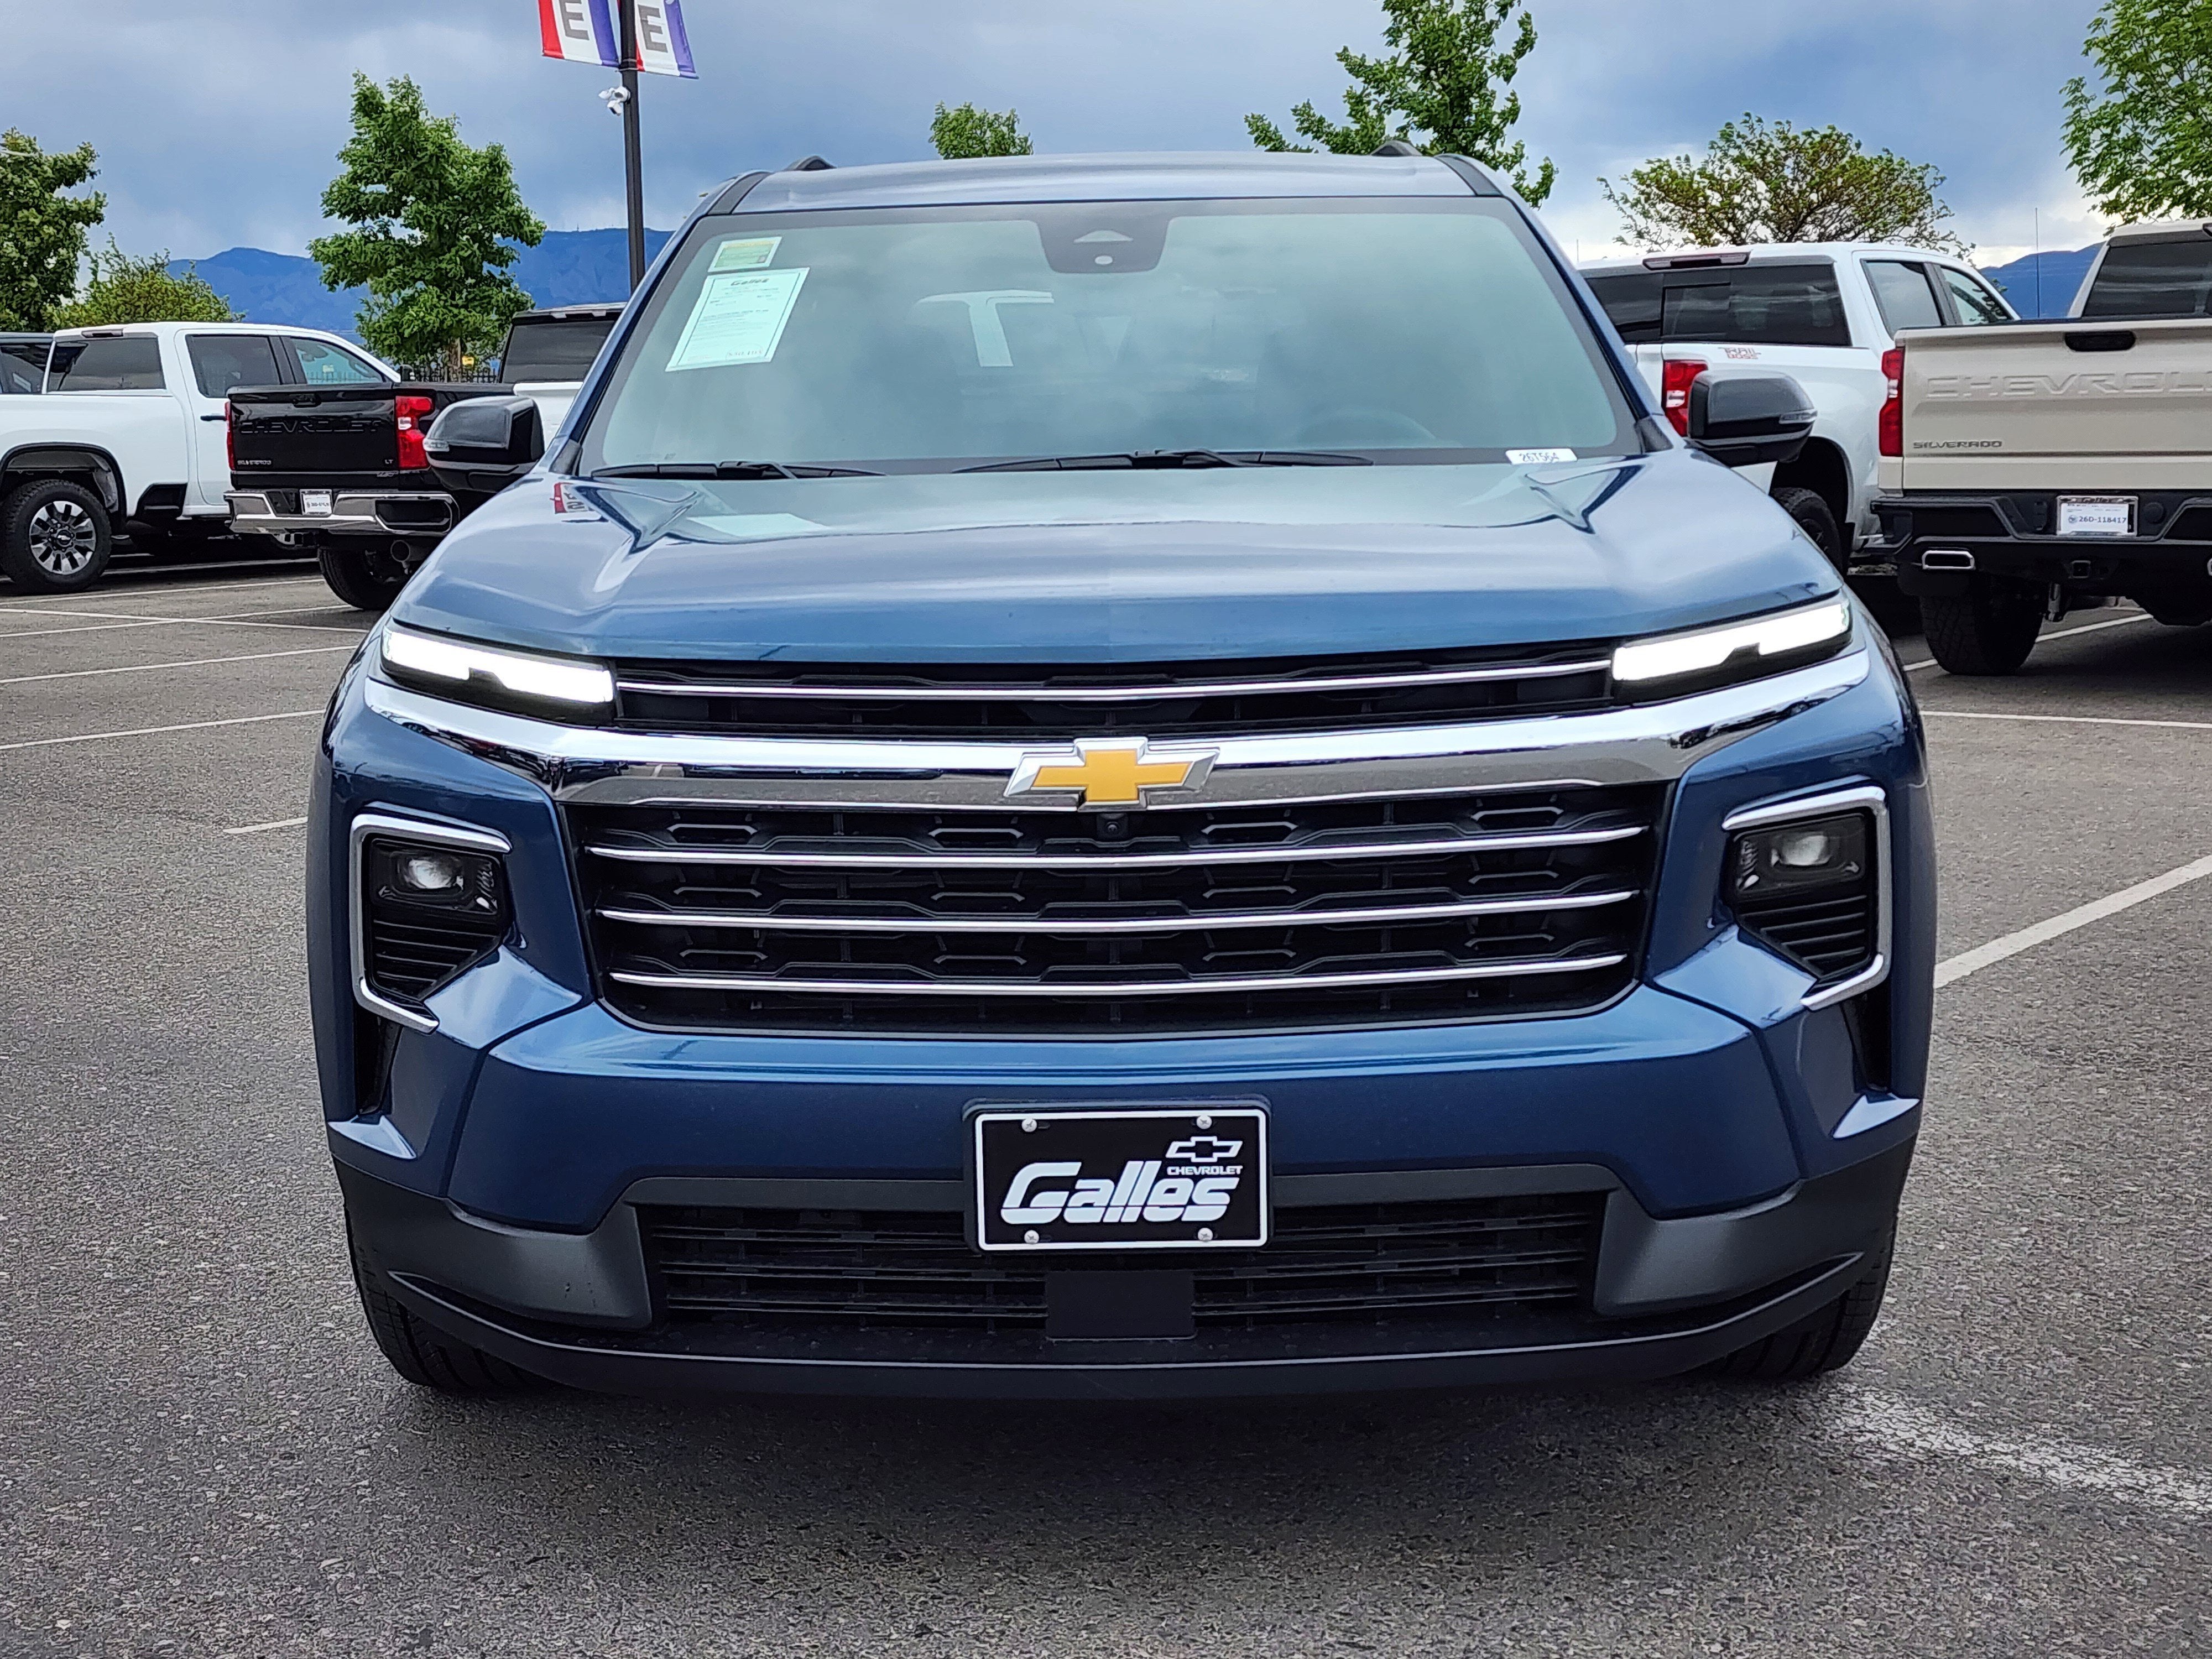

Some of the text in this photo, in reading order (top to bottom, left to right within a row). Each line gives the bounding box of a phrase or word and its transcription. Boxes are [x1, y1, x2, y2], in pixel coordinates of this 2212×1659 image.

[559, 0, 589, 40] E
[638, 4, 668, 53] E
[1913, 440, 2002, 449] SILVERADO
[1167, 1165, 1243, 1175] CHEVROLET
[1001, 1160, 1240, 1224] Galles
